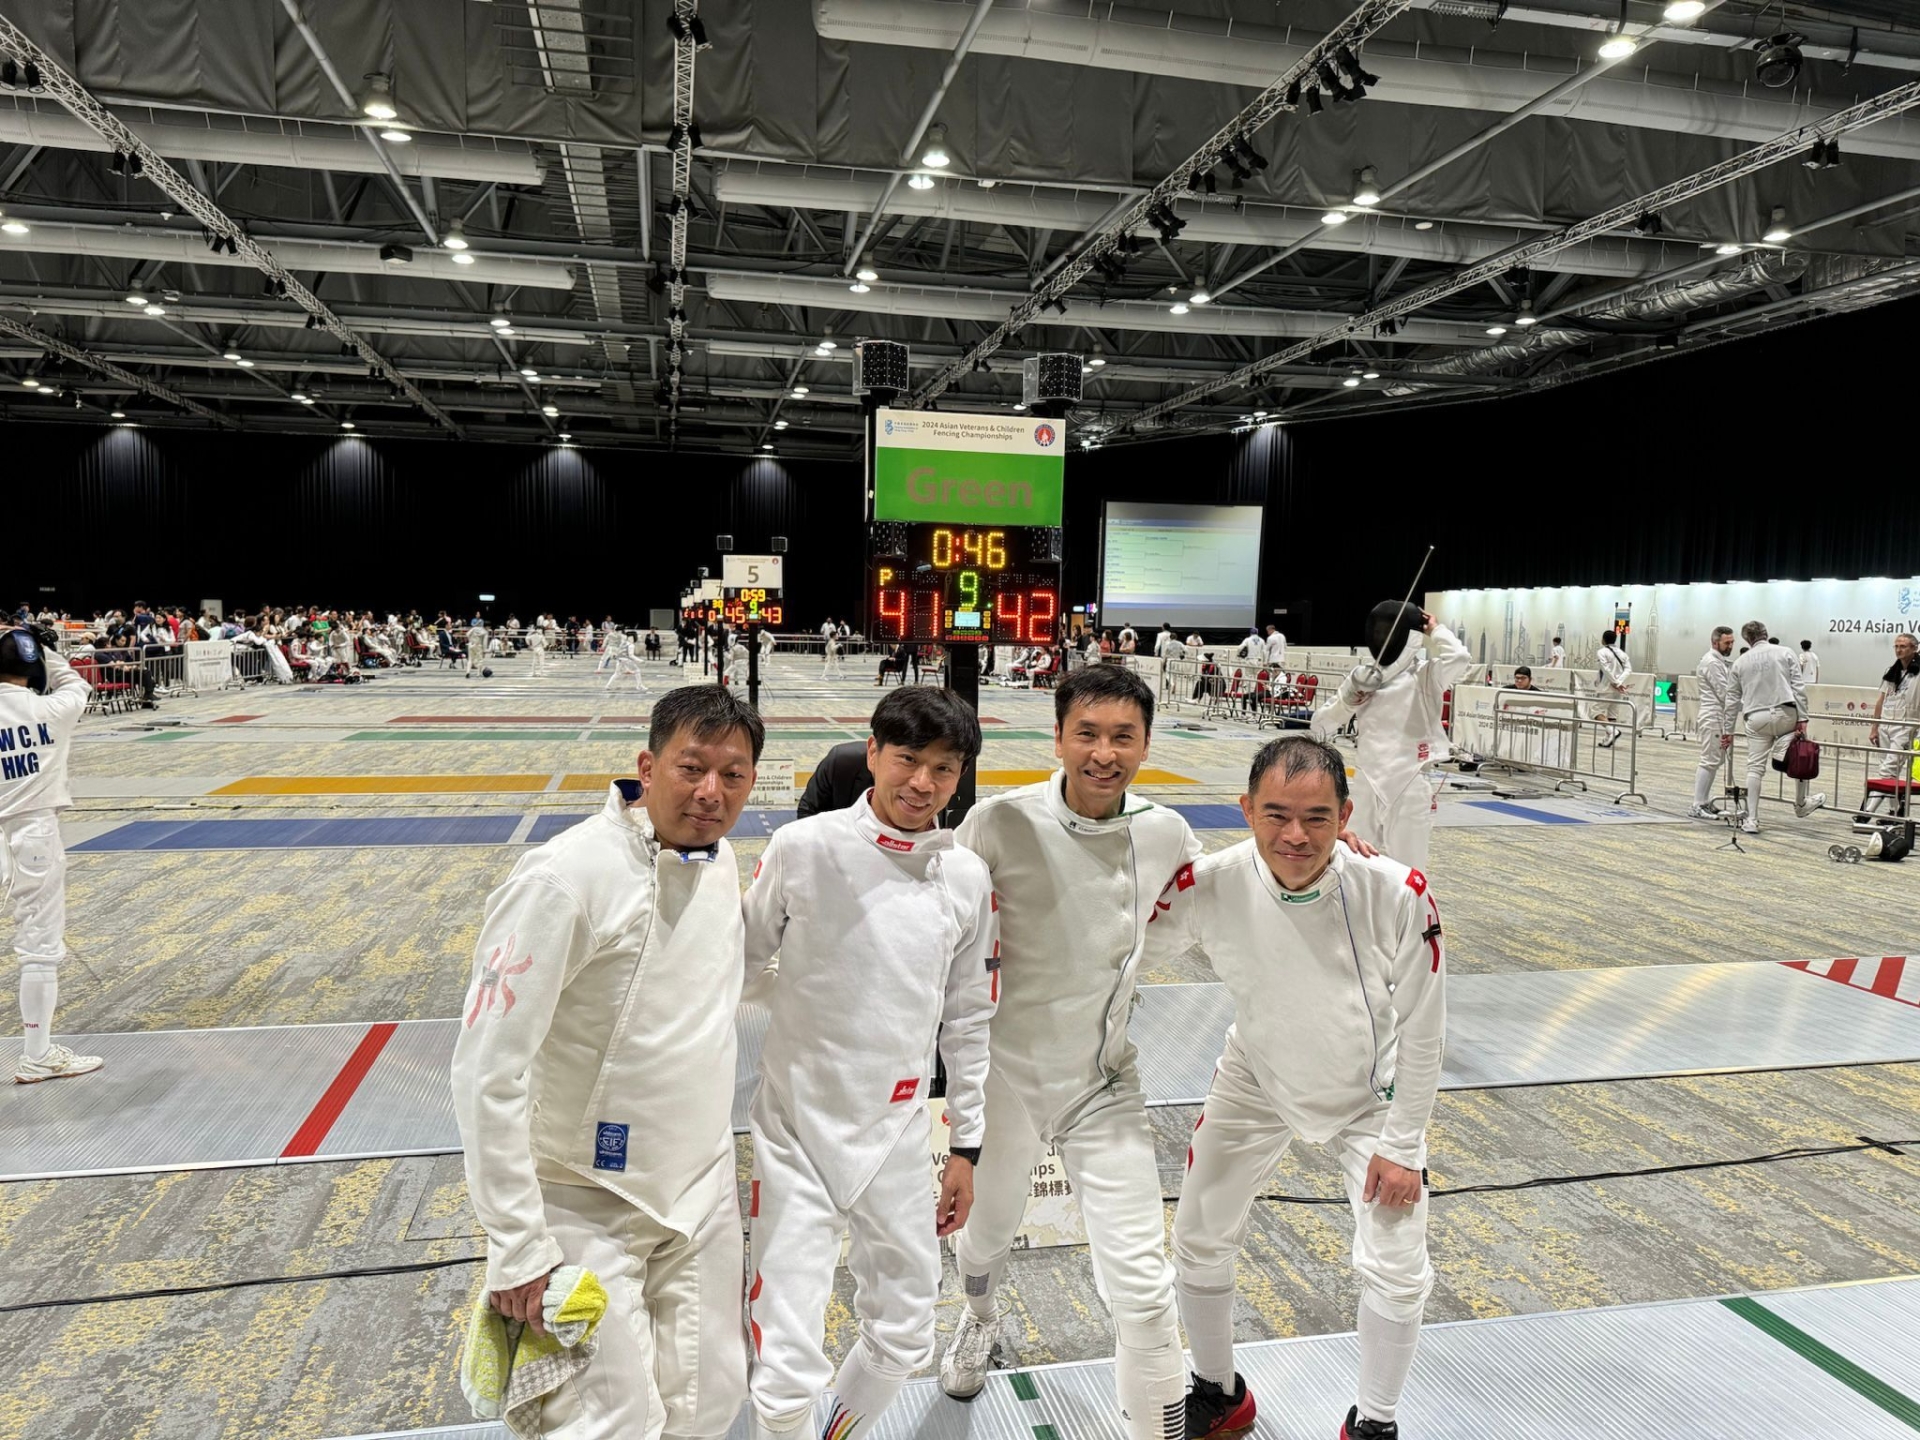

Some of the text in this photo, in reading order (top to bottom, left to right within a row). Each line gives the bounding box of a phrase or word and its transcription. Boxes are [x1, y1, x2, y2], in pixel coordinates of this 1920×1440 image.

[933, 430, 1013, 441] Fencing Championships
[960, 423, 988, 431] Veterans
[996, 426, 1025, 434] Children
[906, 467, 1033, 508] Green
[933, 530, 1005, 569] 0:46
[747, 565, 759, 583] 5
[740, 588, 766, 602] 0:59
[960, 571, 977, 607] 9
[725, 606, 746, 624] 45
[761, 606, 782, 624] 43
[997, 591, 1054, 641] 42
[1829, 618, 1920, 633] 2024 Asian V
[17, 725, 37, 748] C.
[1, 752, 39, 780] HKG
